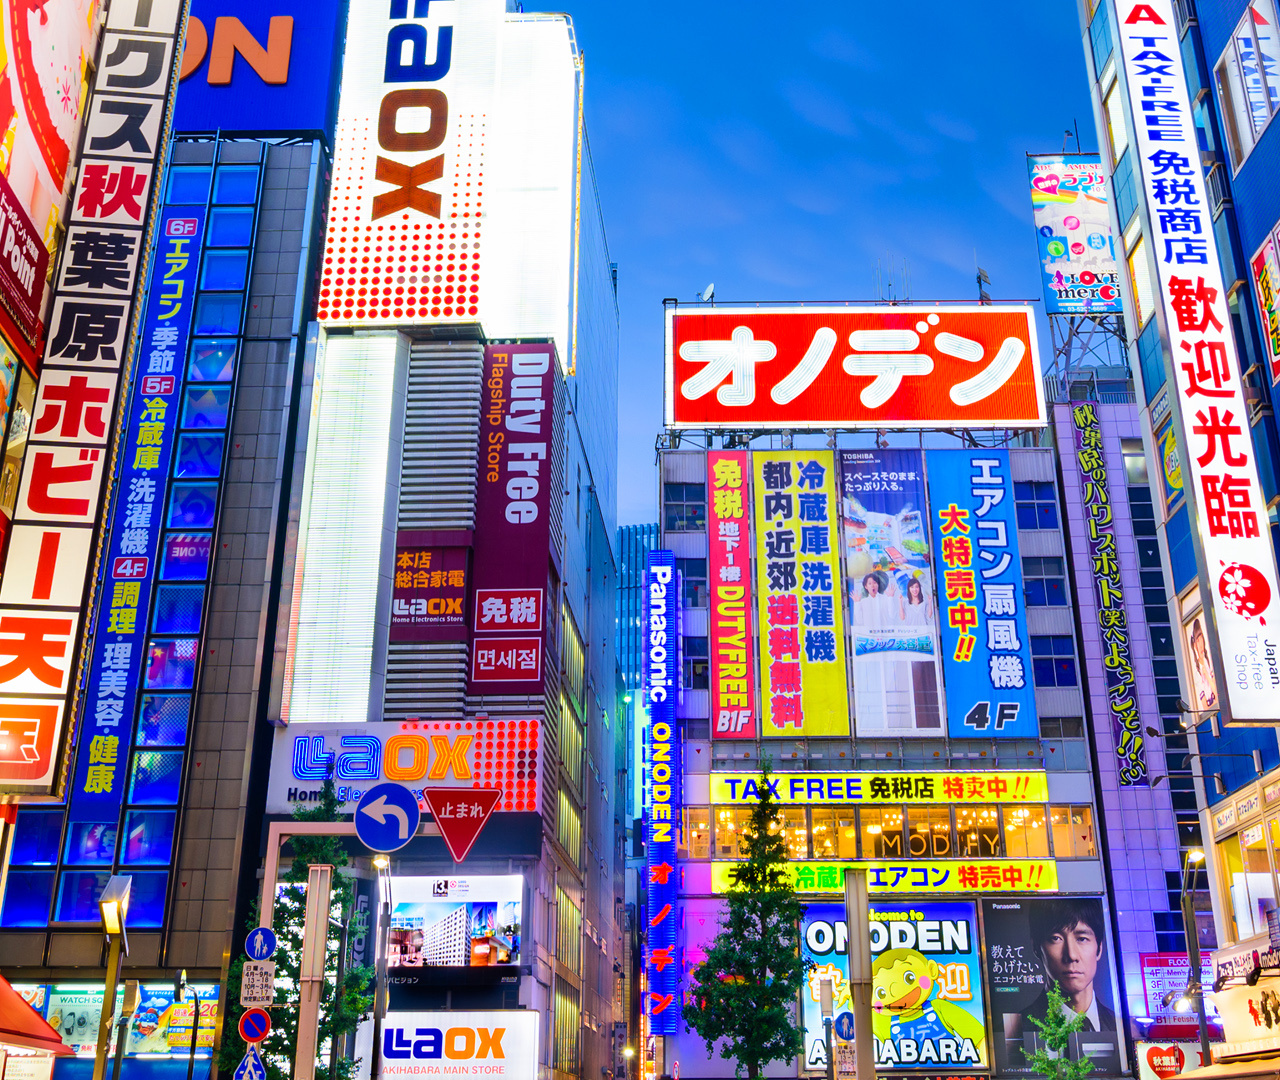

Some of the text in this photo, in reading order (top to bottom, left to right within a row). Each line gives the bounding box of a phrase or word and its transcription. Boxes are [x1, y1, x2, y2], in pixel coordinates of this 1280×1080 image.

[1147, 148, 1209, 266] 免税商店
[171, 221, 194, 234] 6F
[2, 223, 36, 298] Point
[679, 313, 1026, 408] オノデン
[146, 378, 171, 392] 5F
[485, 352, 509, 484] Flagship Store
[1168, 274, 1261, 540] 歓迎光臨
[504, 352, 552, 525] Duty Free
[711, 457, 746, 520] 免税
[116, 559, 145, 577] 4F
[396, 551, 433, 569] 本店
[480, 596, 538, 625] 免税
[477, 648, 537, 671] 면세점
[1234, 654, 1247, 690] Shop
[1244, 632, 1264, 691] Tax-free
[1264, 638, 1280, 688] Japan.
[715, 710, 752, 734] B1F
[647, 565, 674, 1016] Panasonic ONODEN オノデン
[789, 777, 863, 801] FREE
[869, 775, 935, 800] 免税店
[439, 802, 486, 819] 止まれ
[868, 866, 950, 888] エアコン
[909, 910, 923, 921] to
[991, 945, 1023, 958] 教えて
[992, 960, 1039, 973] あげたい
[936, 961, 972, 1003] 迎
[383, 1066, 505, 1074] AKIHABARA MAIN STORE
